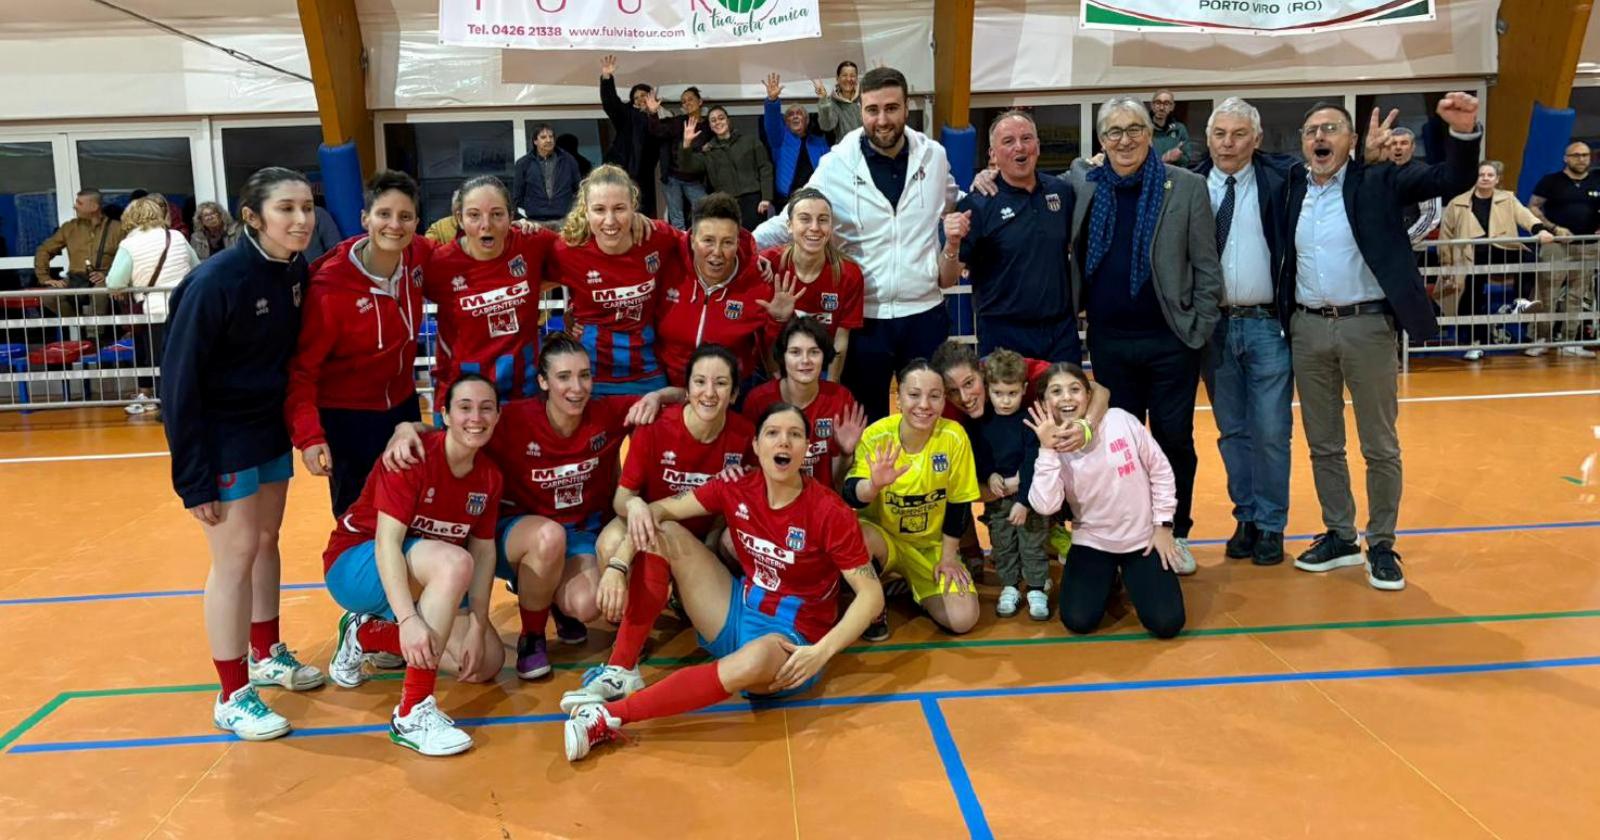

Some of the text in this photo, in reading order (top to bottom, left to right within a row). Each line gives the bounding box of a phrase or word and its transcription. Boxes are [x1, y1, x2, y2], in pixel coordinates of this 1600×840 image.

[1200, 0, 1322, 14] PORTO VIRO (RO)
[692, 12, 706, 35] la
[769, 7, 809, 26] amica
[467, 24, 685, 38] Tel. 0426 21338 www.fulviatour.com
[472, 298, 526, 317] CARPENTERIA
